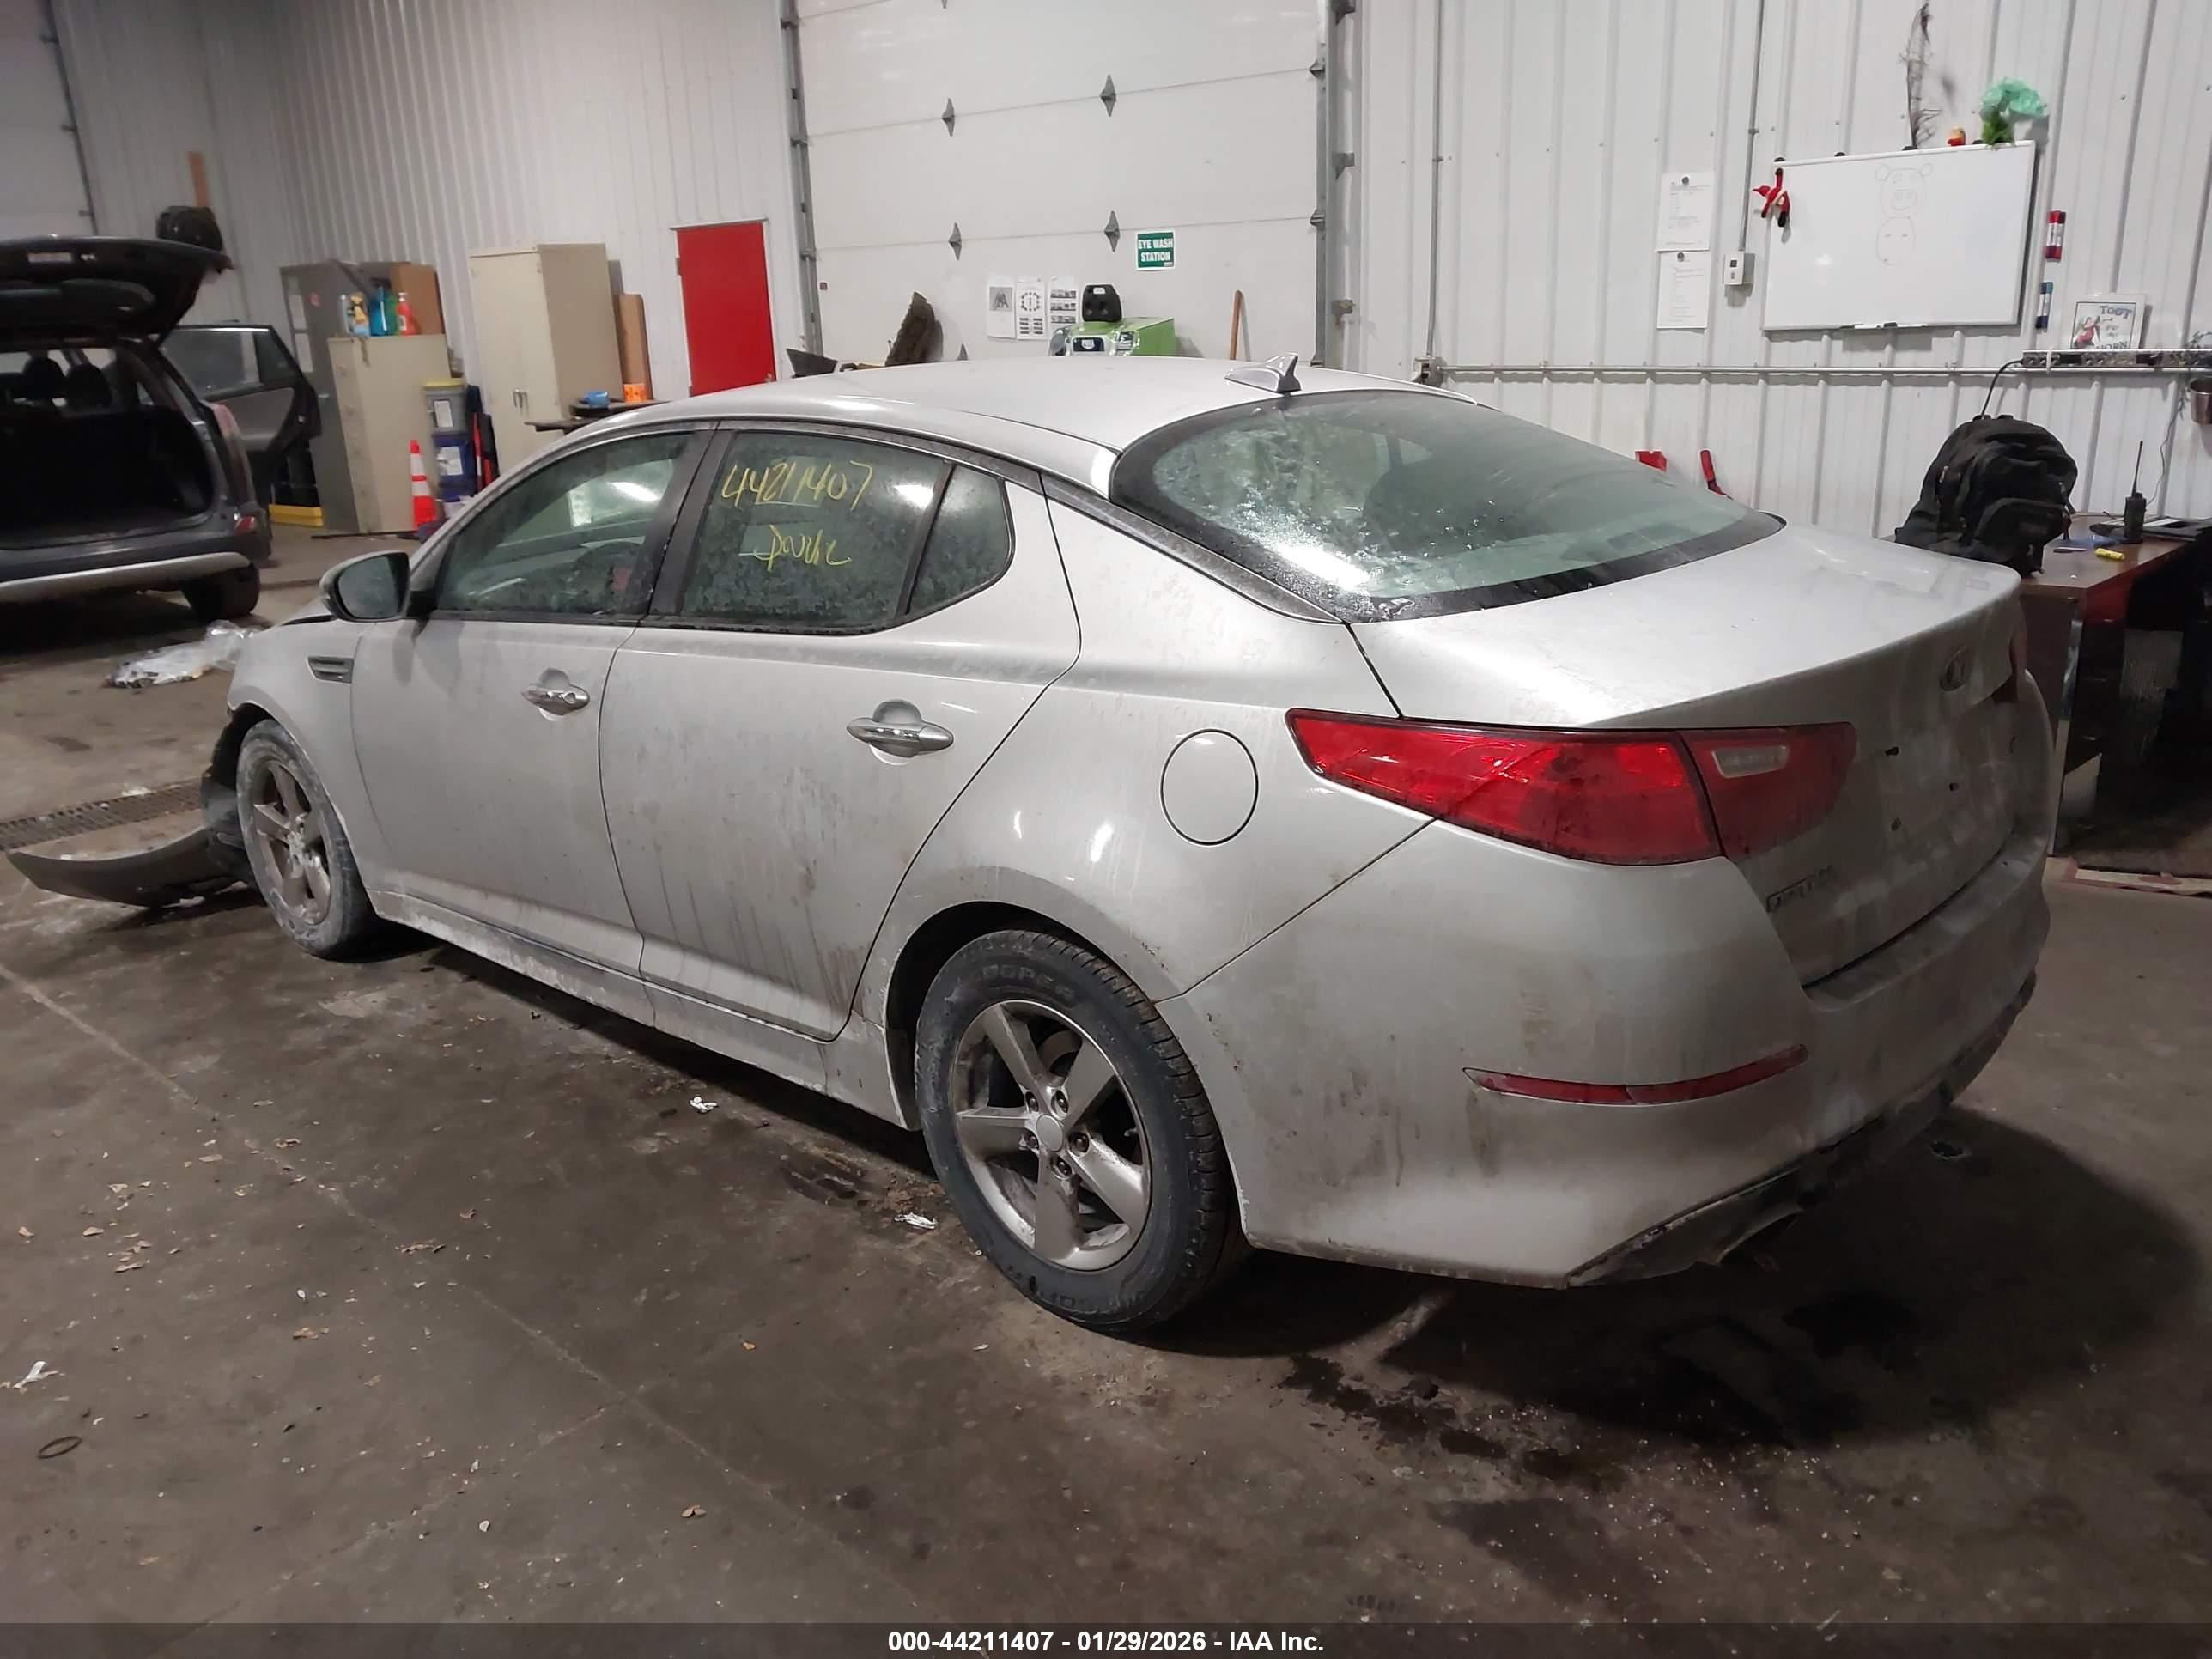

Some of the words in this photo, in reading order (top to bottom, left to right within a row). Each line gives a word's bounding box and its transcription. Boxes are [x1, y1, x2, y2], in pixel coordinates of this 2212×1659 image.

[1138, 239, 1152, 249] EYE
[1152, 238, 1173, 249] WASH
[1140, 251, 1170, 262] STATION
